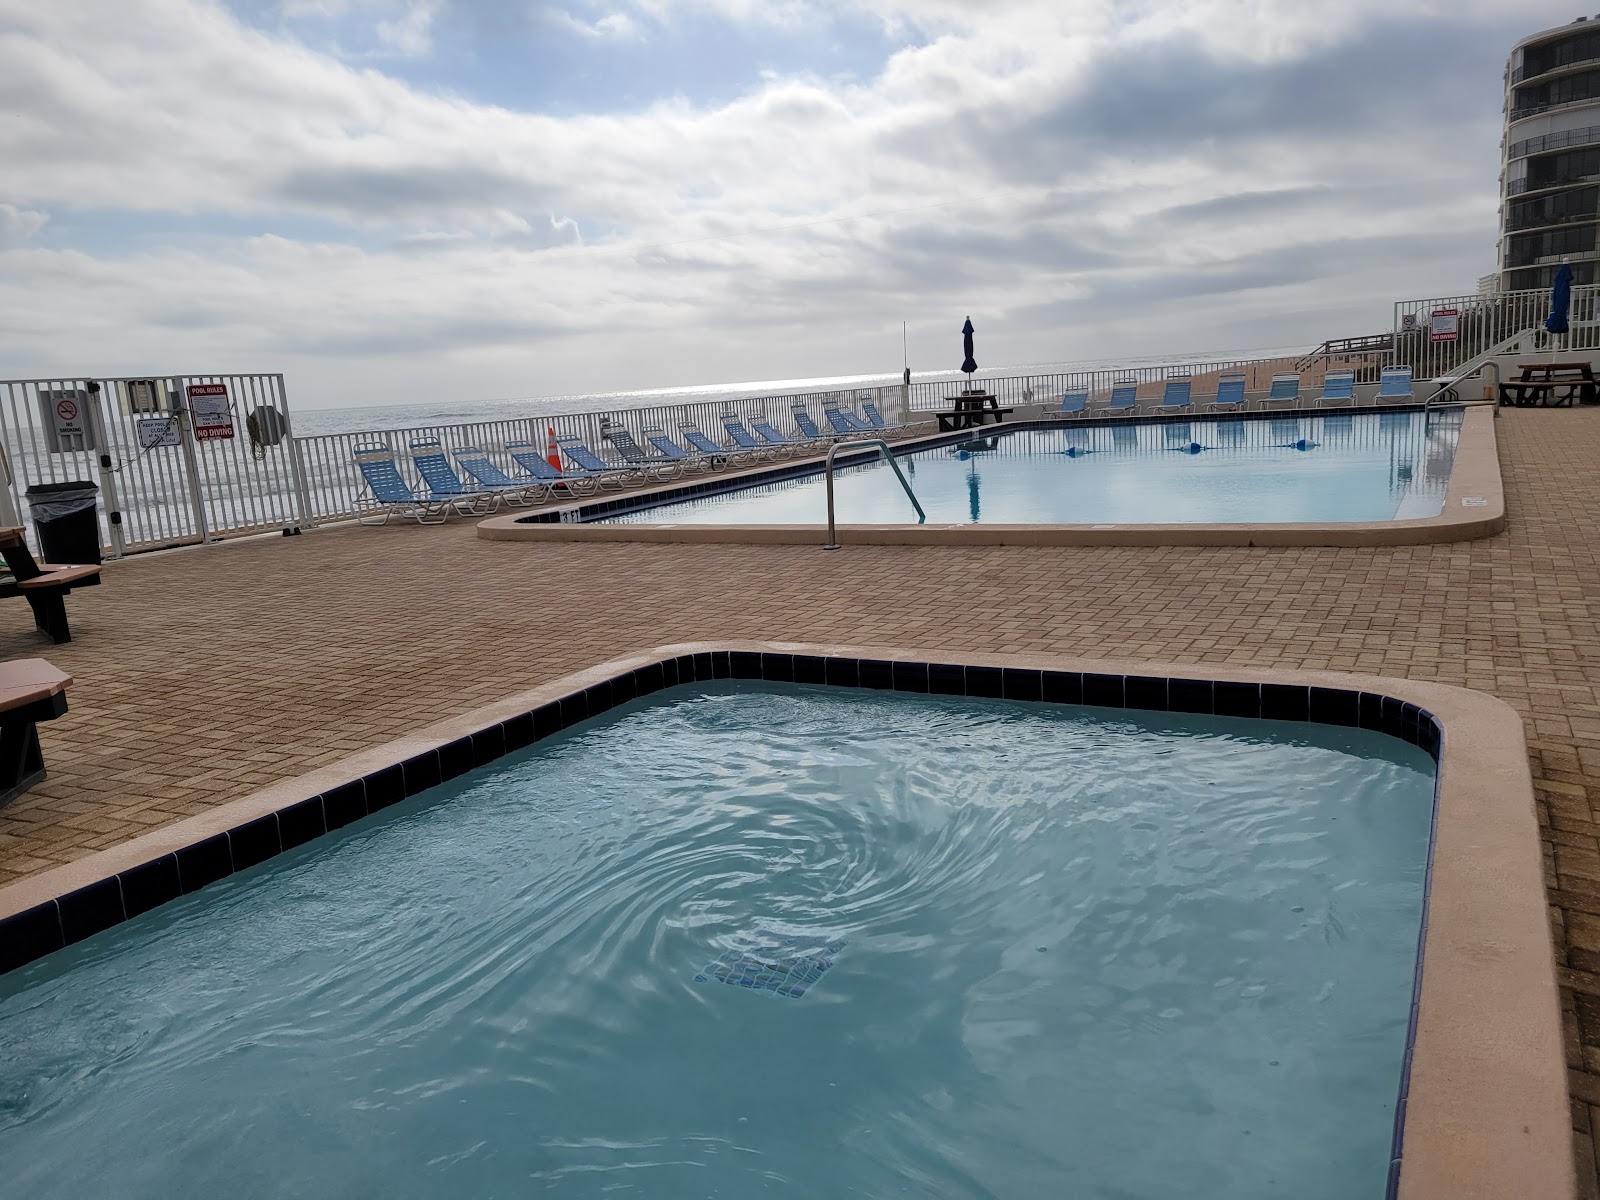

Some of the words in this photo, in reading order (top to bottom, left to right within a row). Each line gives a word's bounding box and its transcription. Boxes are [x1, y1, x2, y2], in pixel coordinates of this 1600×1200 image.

[197, 429, 208, 438] NO
[209, 427, 233, 437] DIVING
[562, 512, 568, 524] 3
[571, 510, 579, 524] FT
